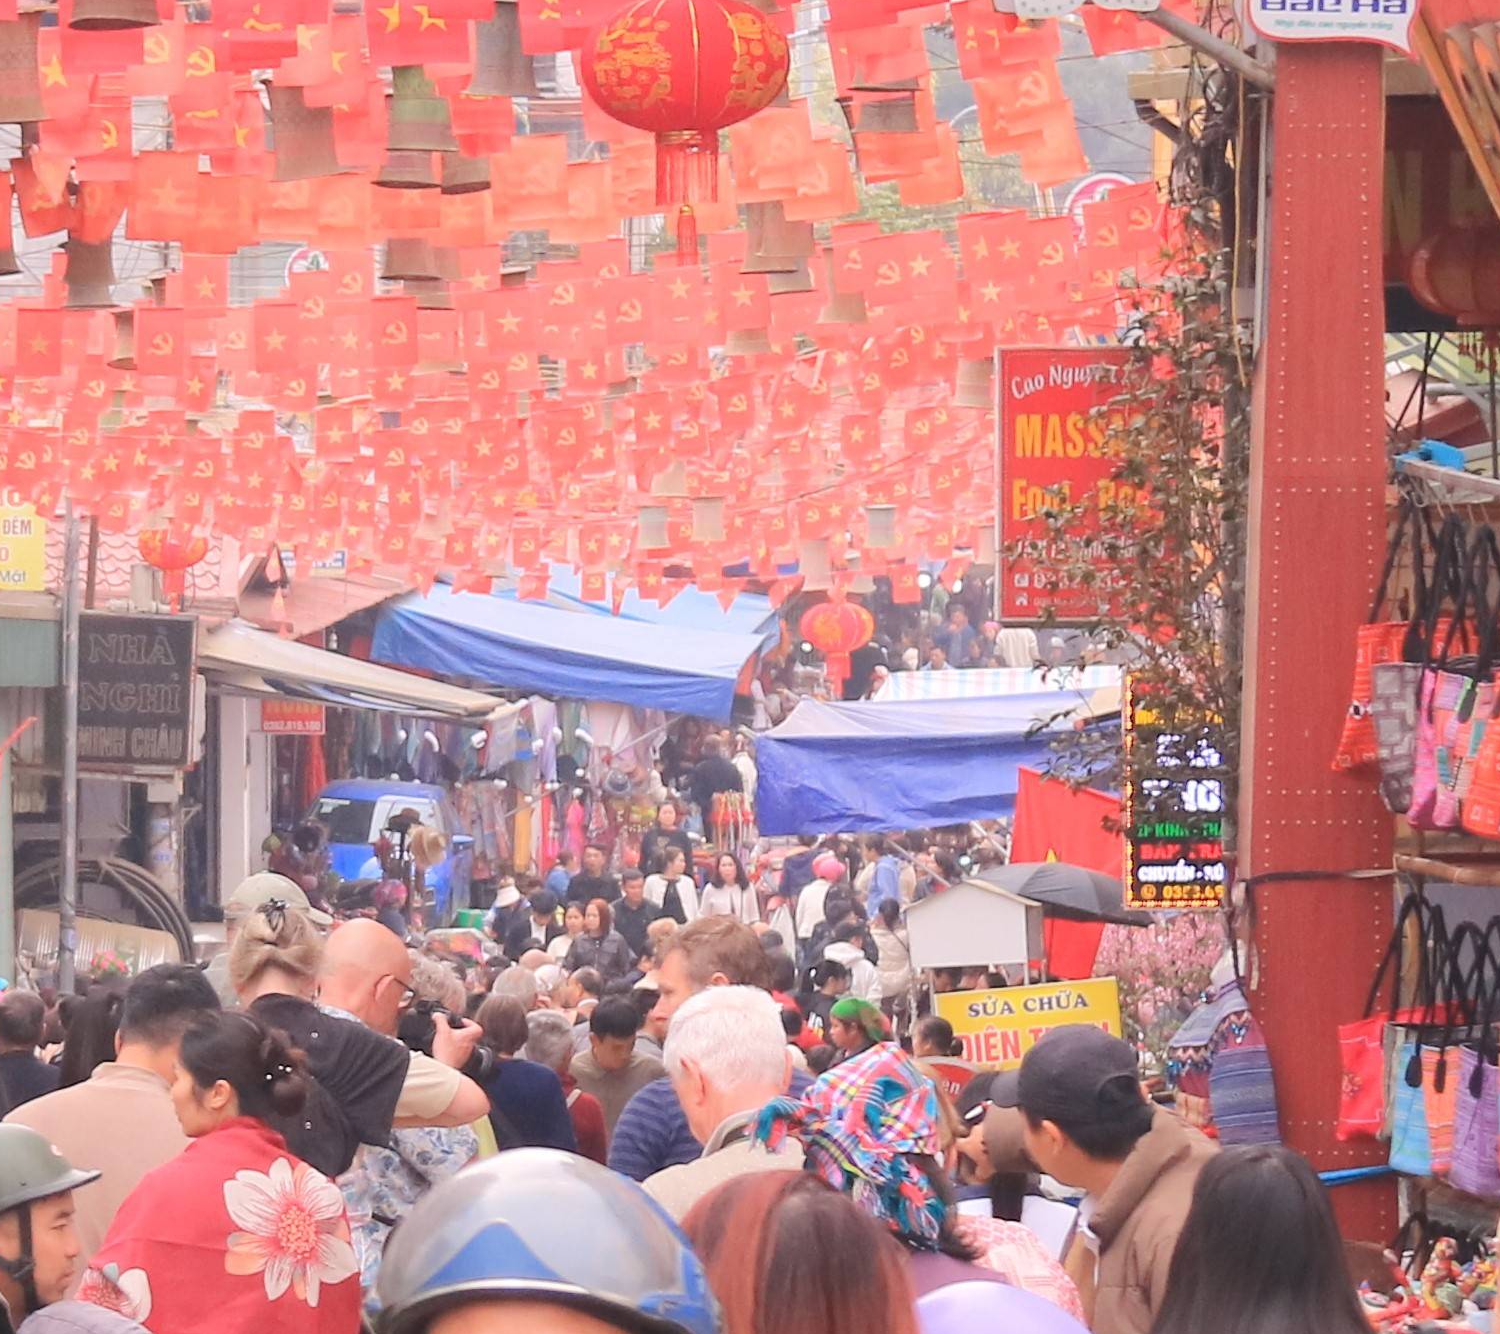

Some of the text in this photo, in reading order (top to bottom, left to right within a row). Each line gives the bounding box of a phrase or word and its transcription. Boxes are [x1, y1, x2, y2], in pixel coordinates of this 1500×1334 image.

[1011, 372, 1045, 401] Cao
[1, 513, 32, 536] ĐÊM
[87, 624, 177, 666] NHÀ
[78, 672, 182, 714] NGHỈ
[77, 723, 183, 759] MINH CHÂU
[967, 990, 1089, 1018] SỬA CHỮA
